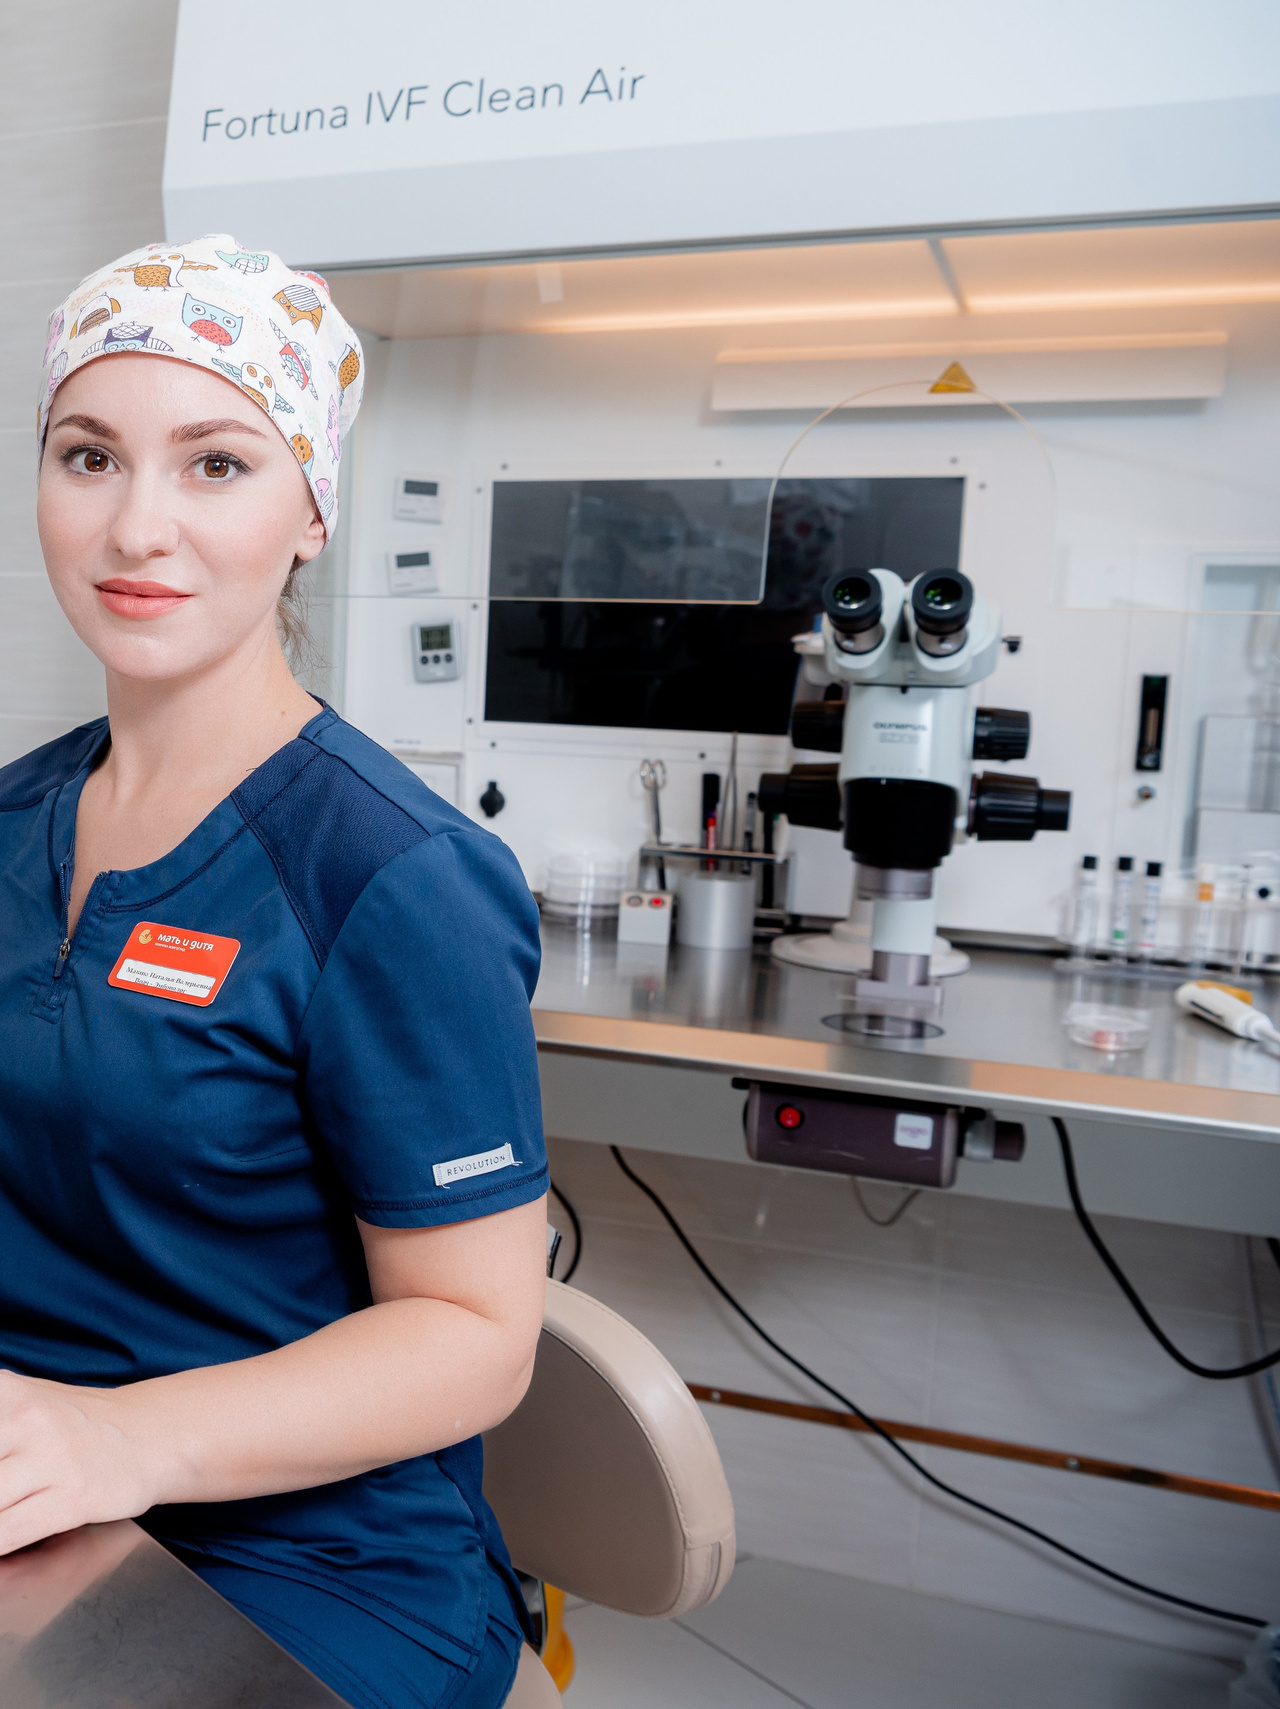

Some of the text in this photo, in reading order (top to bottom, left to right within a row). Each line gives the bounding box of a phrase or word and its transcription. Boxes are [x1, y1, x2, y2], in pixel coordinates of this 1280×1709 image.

[202, 66, 646, 142] Fortuna IVF Clean Air
[447, 1155, 506, 1177] REVOLUTION
